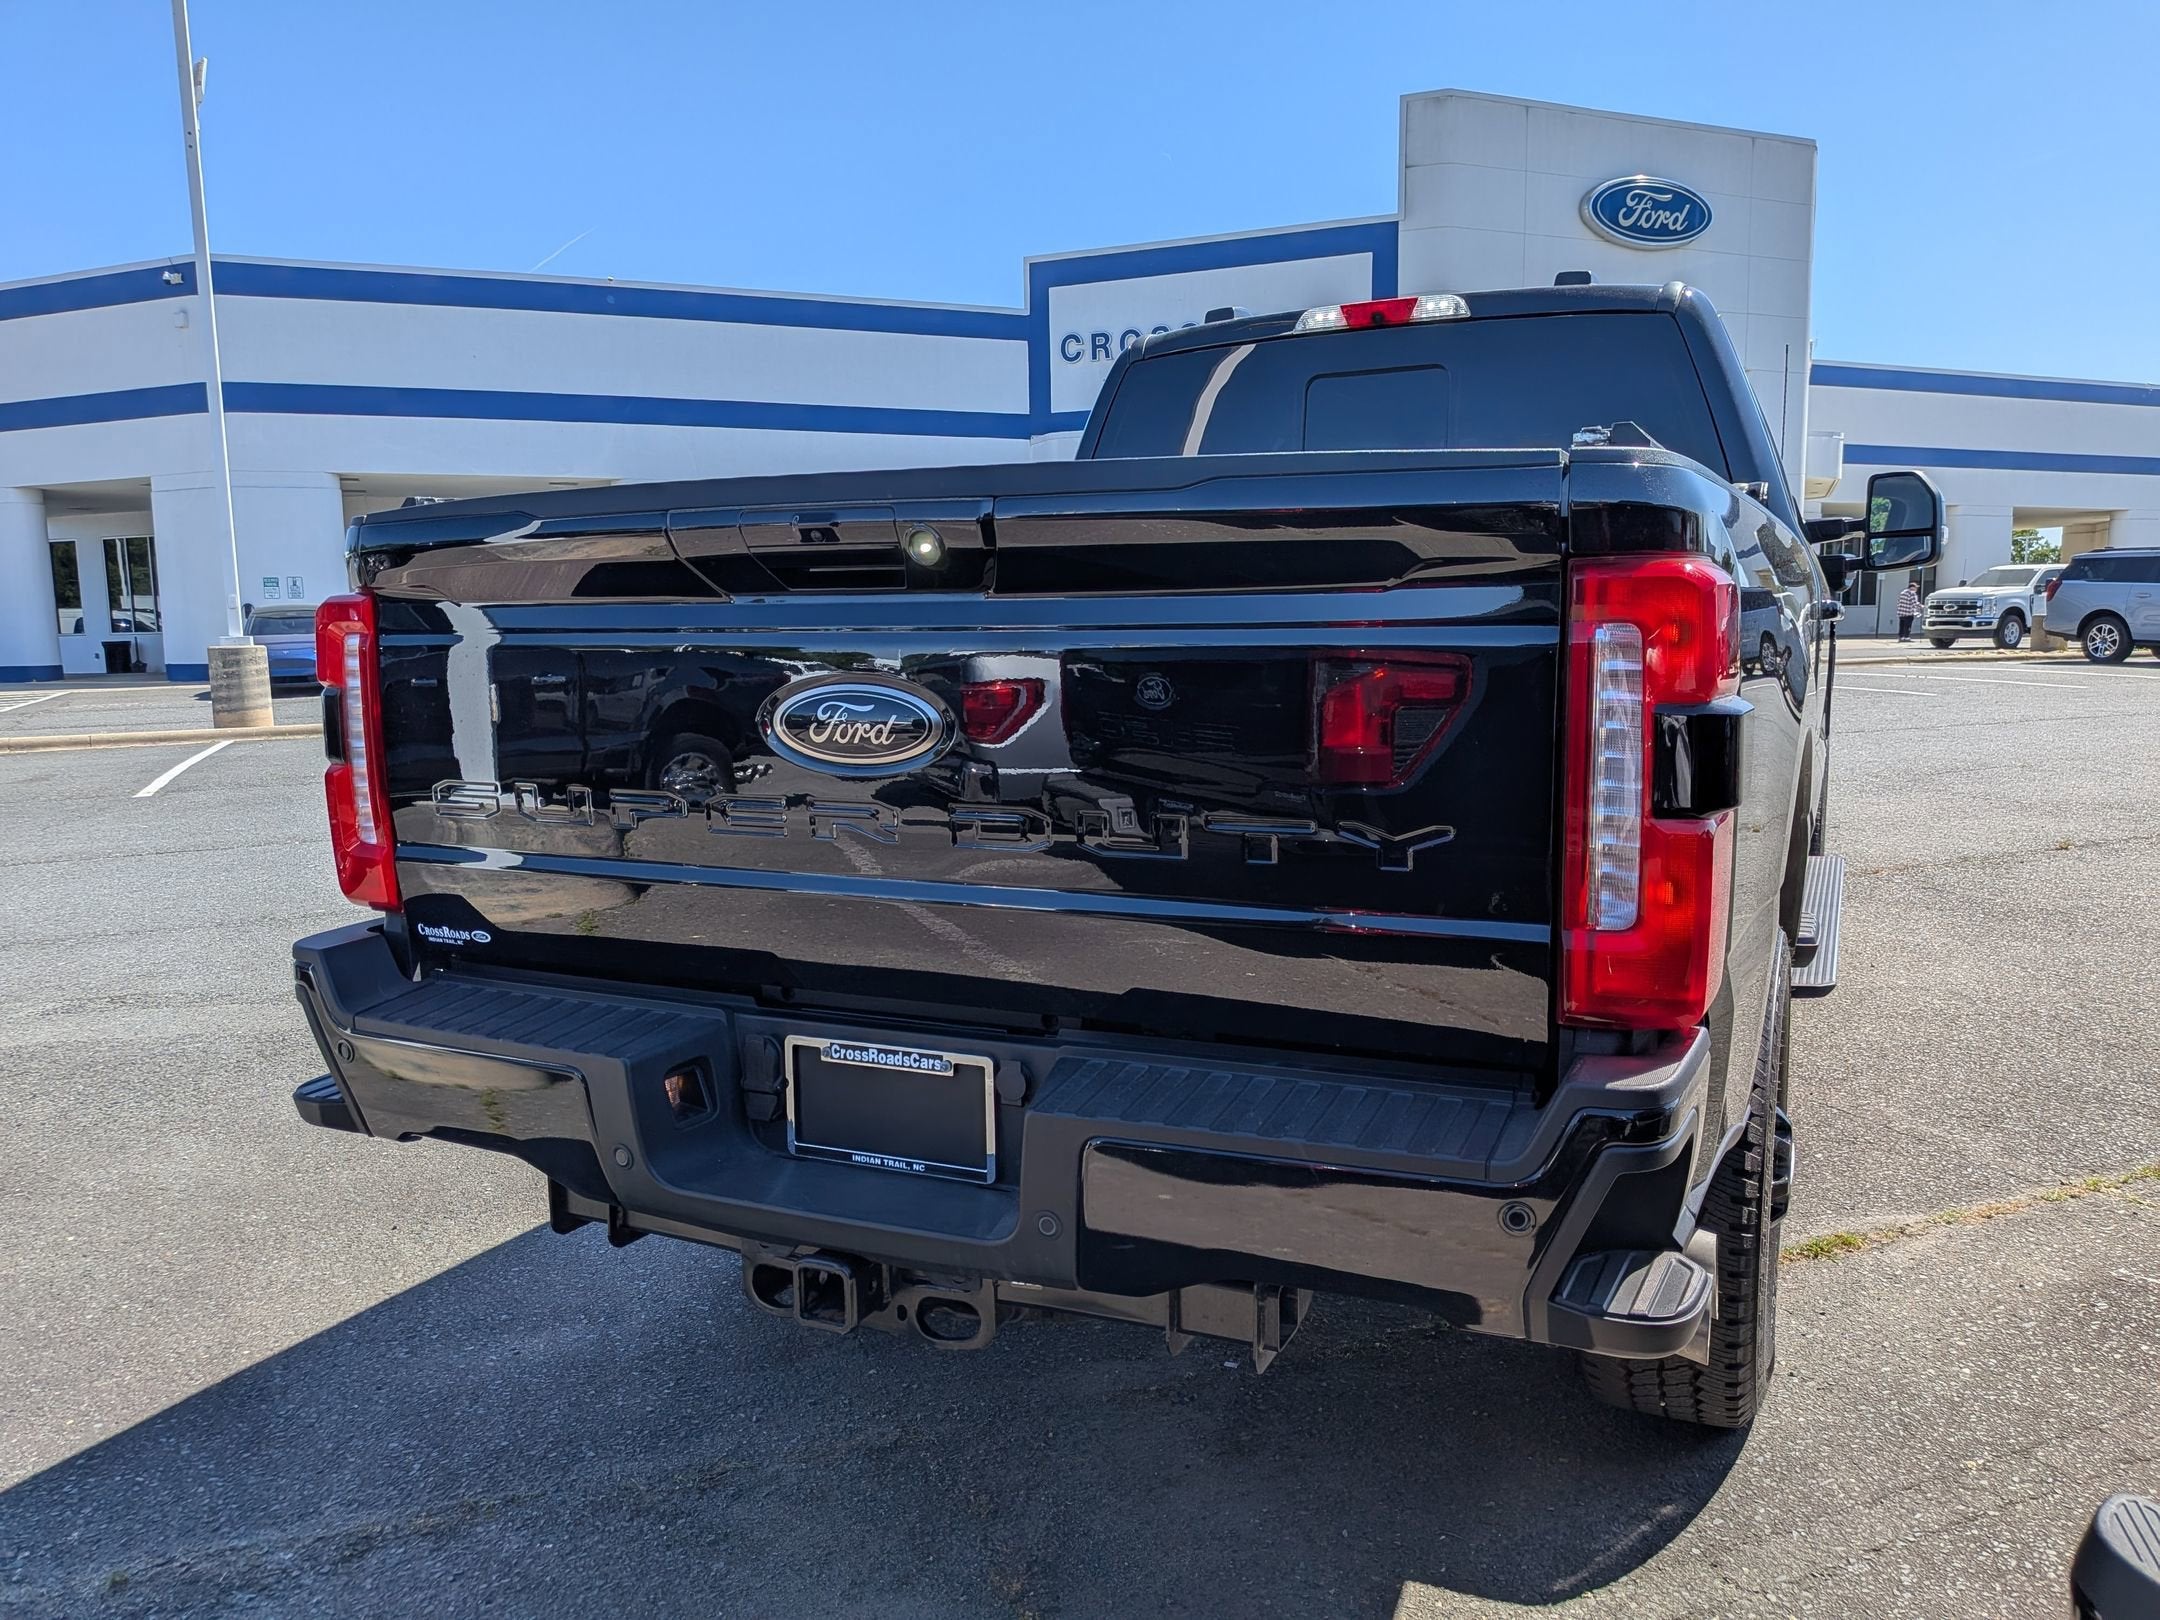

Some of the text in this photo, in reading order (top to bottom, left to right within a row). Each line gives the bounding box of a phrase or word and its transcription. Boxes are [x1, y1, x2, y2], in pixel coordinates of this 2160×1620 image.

[1618, 189, 1690, 231] Ford
[809, 701, 898, 745] Ford
[431, 779, 1456, 871] SUPER DUTY
[831, 1044, 941, 1071] CrossRoadsCars
[852, 1154, 926, 1172] INDIAN TRAIL, NC
